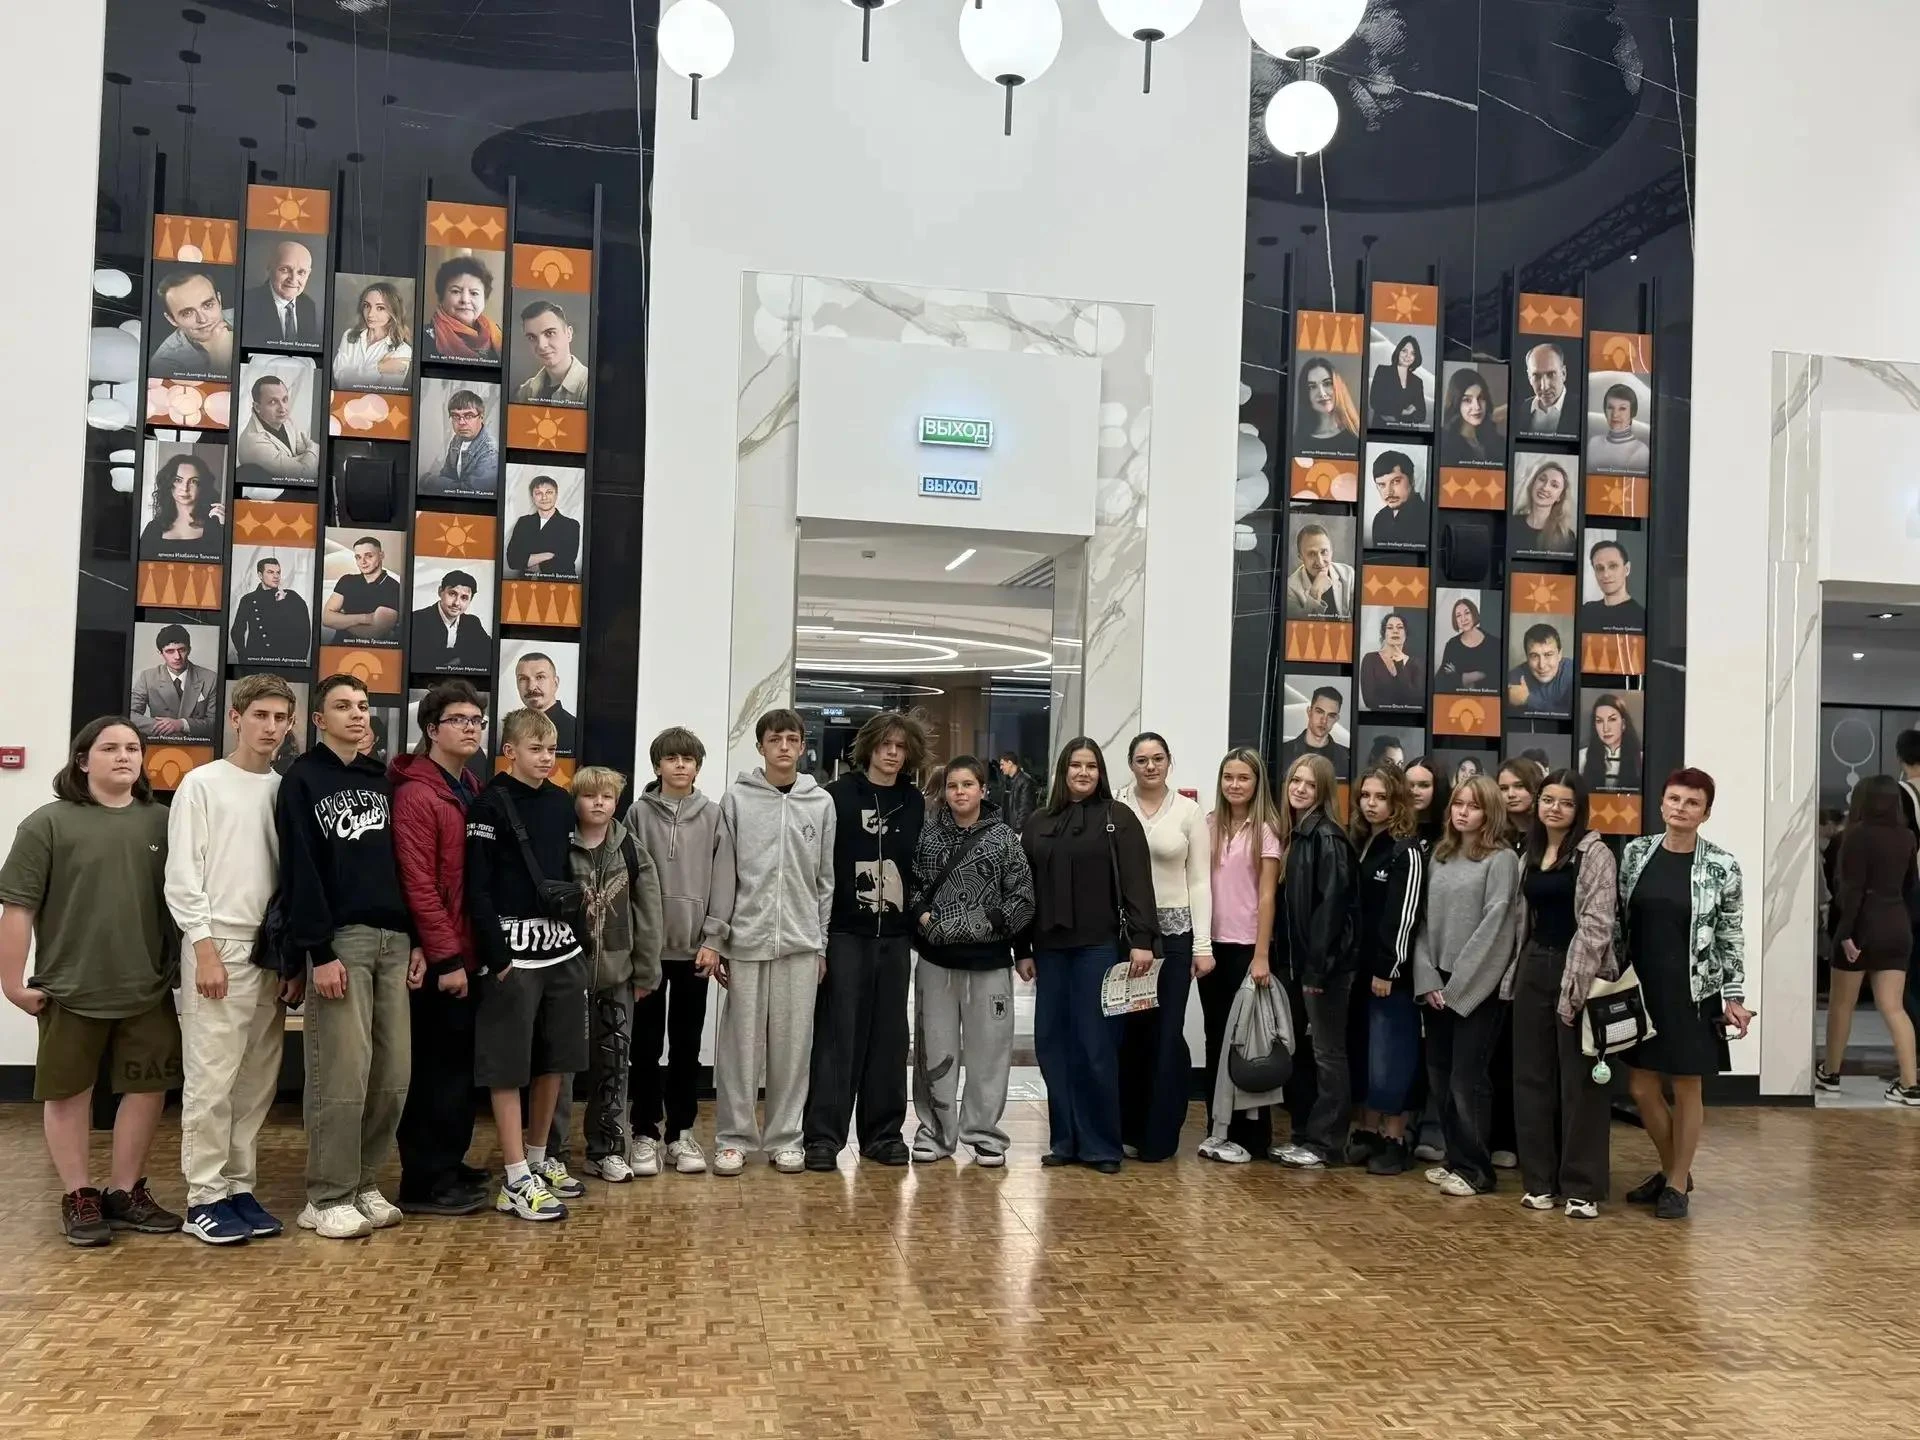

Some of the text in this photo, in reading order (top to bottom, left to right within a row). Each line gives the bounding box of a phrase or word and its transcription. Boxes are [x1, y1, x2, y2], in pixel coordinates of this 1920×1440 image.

[925, 419, 988, 443] ВЫХОД
[925, 478, 976, 495] ВЫХОД
[314, 789, 358, 840] HIGH
